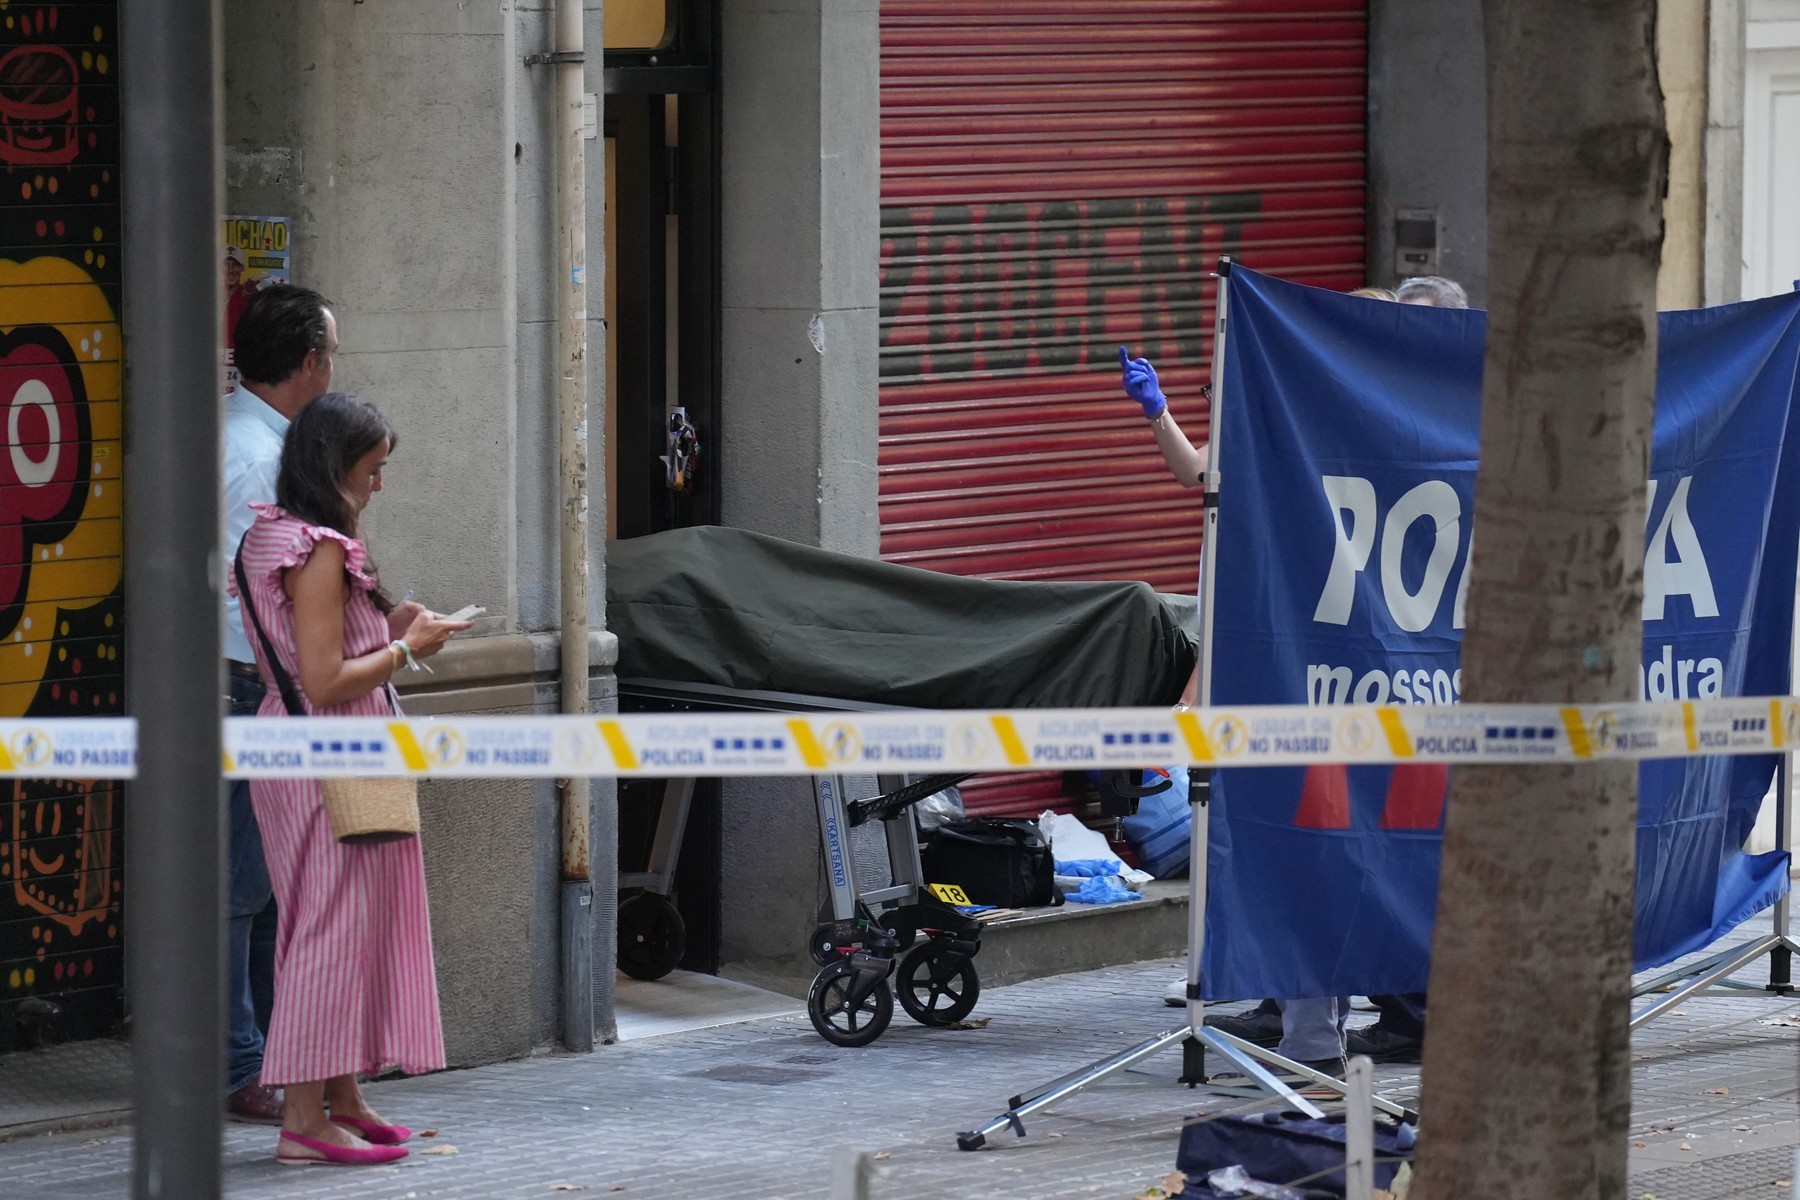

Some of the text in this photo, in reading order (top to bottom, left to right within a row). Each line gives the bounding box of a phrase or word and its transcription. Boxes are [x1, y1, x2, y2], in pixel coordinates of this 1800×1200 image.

[863, 744, 943, 759] NO PASSEU
[1034, 744, 1095, 760] POLICIA
[1249, 738, 1330, 753] NO PASSEU
[1416, 736, 1478, 753] POLICIA
[54, 750, 75, 765] NO
[237, 751, 302, 767] POLICIA
[467, 749, 550, 765] NO PASSEU
[641, 750, 704, 765] POLICIA
[827, 823, 844, 886] KARTSANA
[939, 886, 966, 903] 18
